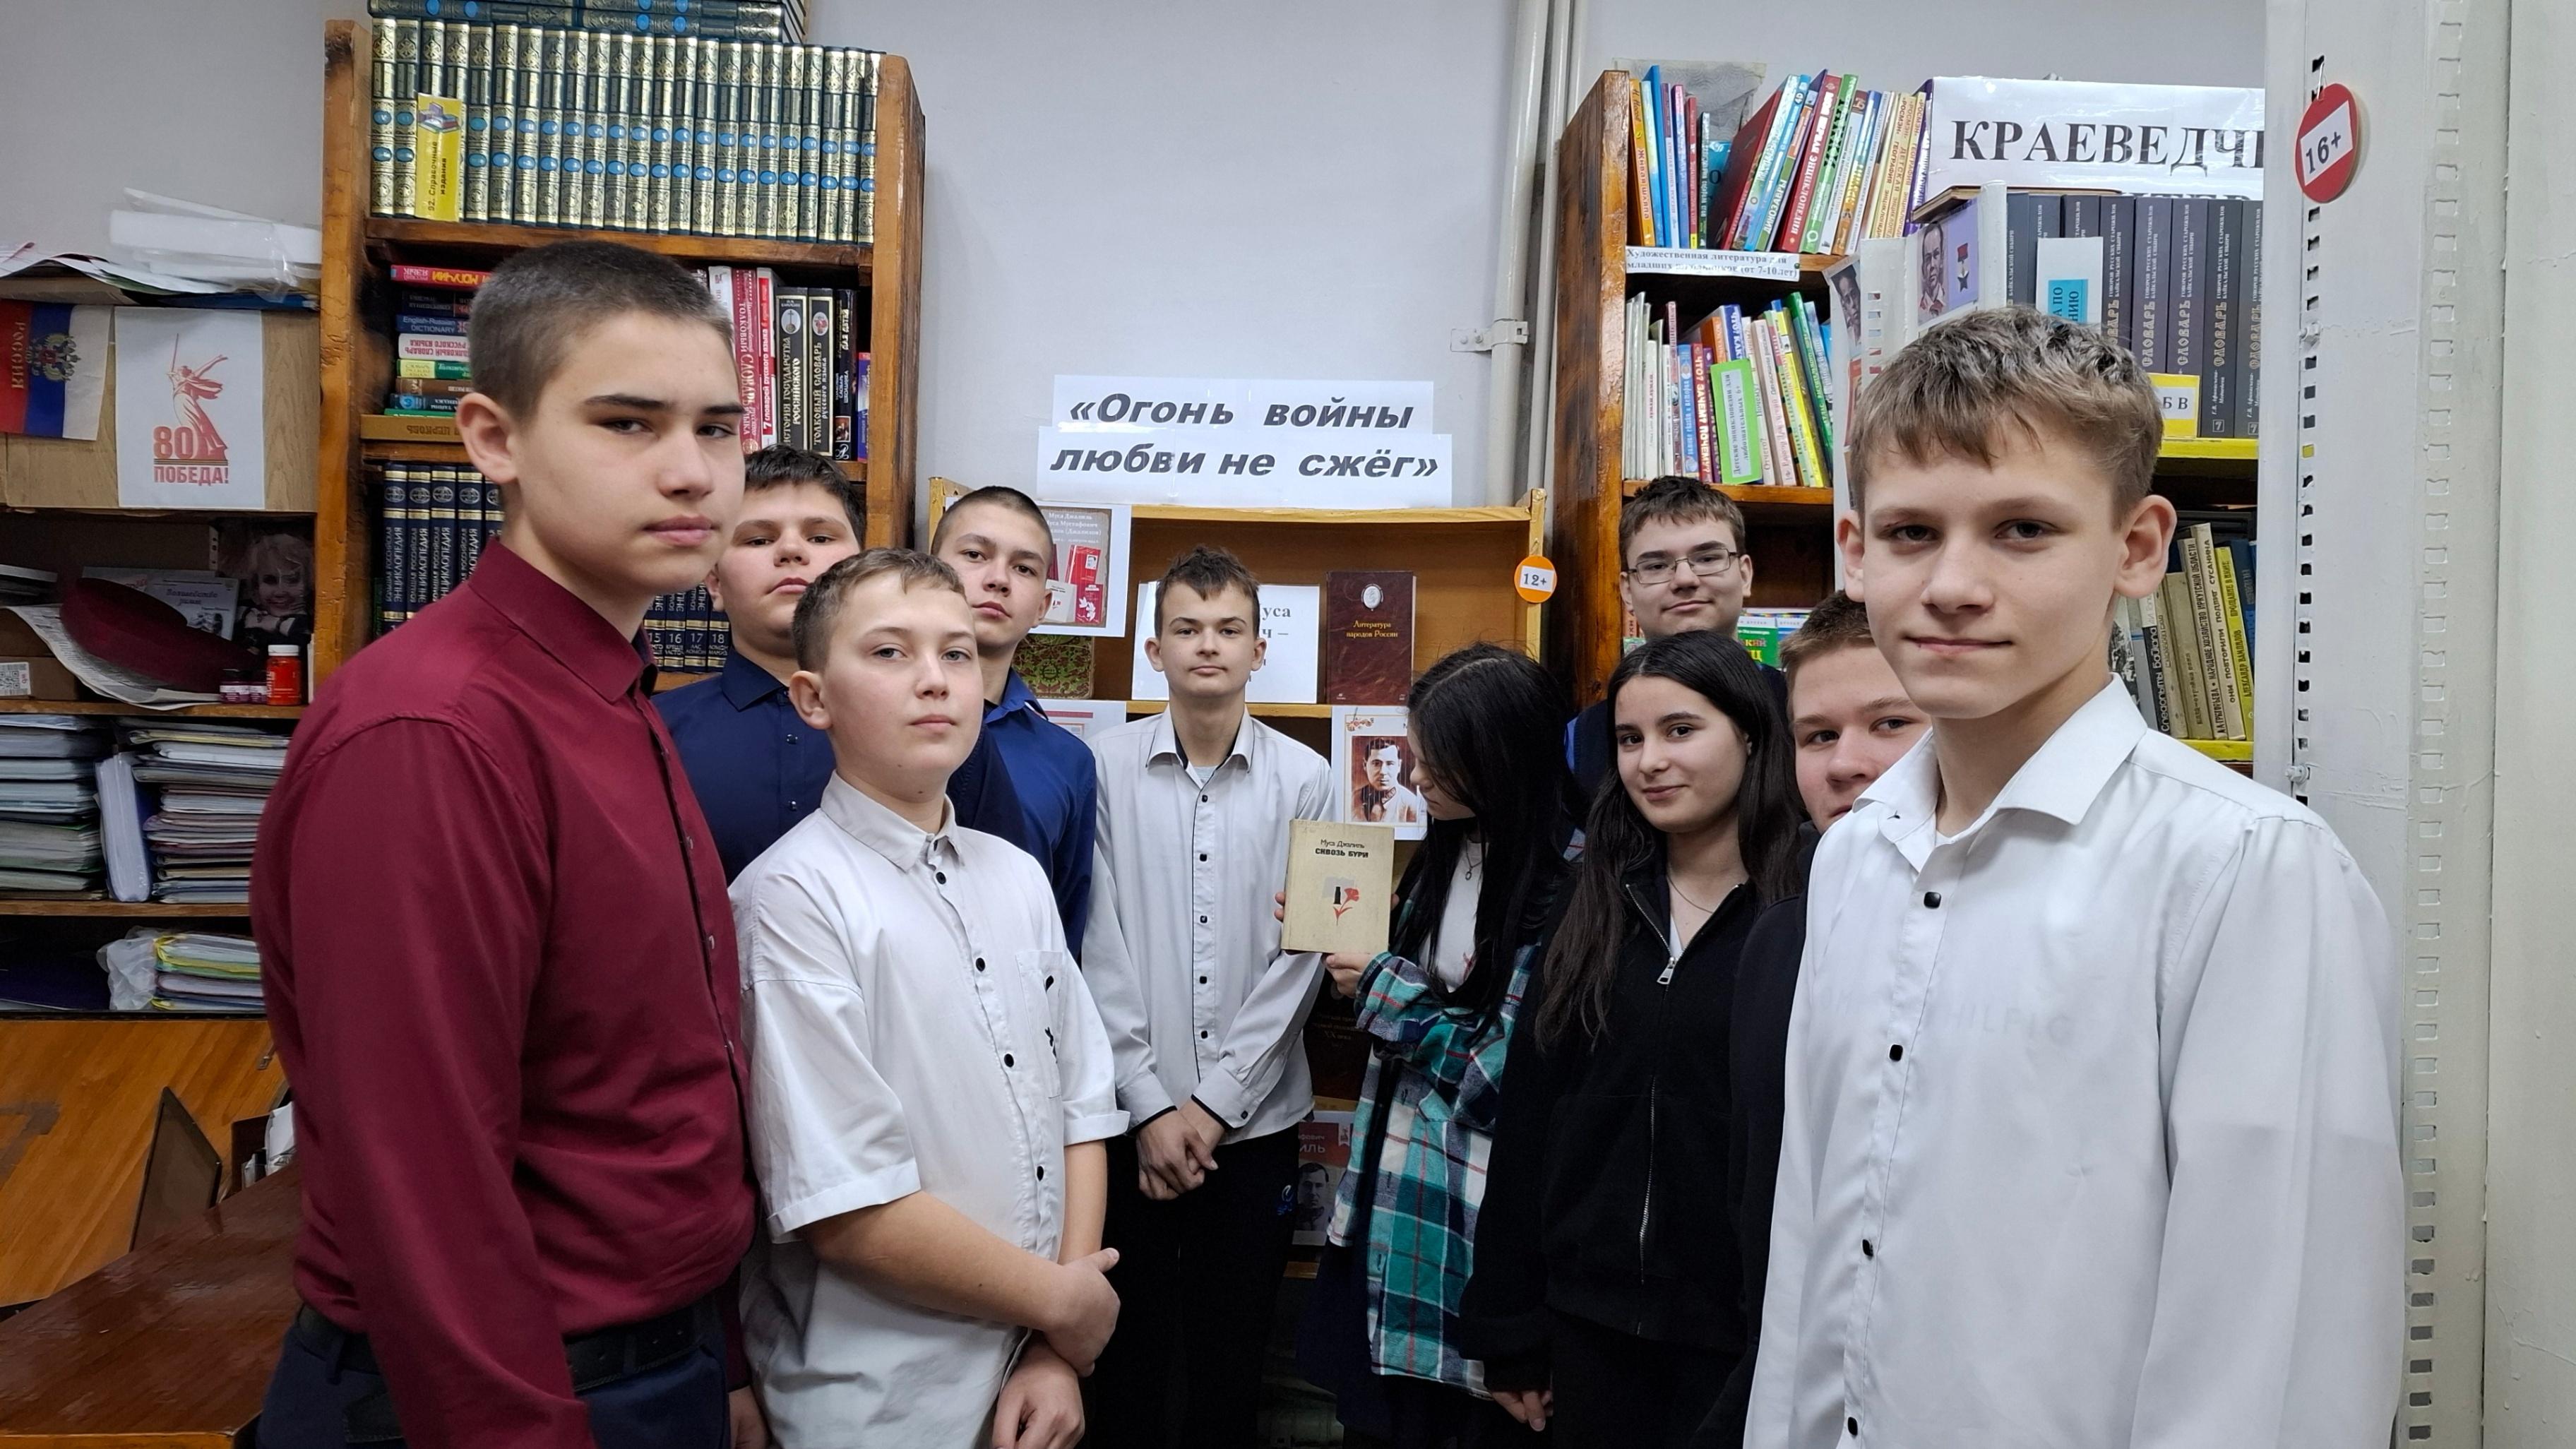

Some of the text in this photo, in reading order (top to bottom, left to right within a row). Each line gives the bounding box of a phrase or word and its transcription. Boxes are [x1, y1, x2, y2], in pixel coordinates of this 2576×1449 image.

[428, 141, 438, 196] Справочные
[1886, 141, 1900, 184] ГЕОГРАФИЯ
[1895, 146, 1907, 192] ДЕТСКАЯ
[2306, 131, 2341, 174] 16+
[1638, 148, 1650, 219] Живая шляпа
[1791, 155, 1819, 234] ЭНЦИКЛОПЕДИЯ
[1763, 179, 1787, 234] ДИНОЗАВРЫ
[403, 268, 429, 276] ЯЗЫК
[1626, 249, 1767, 264] Художественная литература
[432, 271, 478, 285] МОГУЧИЙ
[2053, 287, 2063, 304] ПО
[402, 316, 455, 326] English-Russian
[410, 325, 455, 333] DICTIONARY
[2107, 300, 2119, 345] ОВАРЬ
[2142, 302, 2155, 367] СЛОВАРЬ
[2177, 300, 2190, 366] СЛОВАРЬ
[2214, 302, 2227, 366] СЛОВАРЬ
[2249, 304, 2262, 369] СЛОВАРЬ
[11, 321, 26, 389] РОССИЯ
[405, 347, 434, 356] СЛОВАРЬ
[435, 340, 466, 349] РУССКОГО
[739, 302, 756, 405] ТОЛКОВЫЙ СЛОВАРЬ
[782, 337, 792, 400] ГОСУДАРСТВА
[792, 357, 801, 424] РОССИЙСКОГО
[813, 342, 822, 445] ТОЛКОВЫЙ СЛОВАРЬ
[2163, 397, 2188, 410] Б В
[763, 421, 771, 429] 7
[1070, 393, 1414, 429] «Огонь войны
[1695, 355, 1710, 473] ЧТО? ЗАЧЕМ? ПОЧЕМУ?
[1727, 389, 1737, 443] энциклопедии
[153, 426, 194, 459] 80
[406, 425, 450, 436] ЦЕРКОВЬ
[1737, 398, 1749, 460] любознательных
[1049, 443, 1438, 478] любви не сжёг»
[1732, 444, 1741, 475] Детские
[1760, 438, 1771, 470] Отчего?
[153, 465, 229, 487] ПОБЕДА!
[1049, 512, 1092, 521] Муса Джалиль
[393, 527, 403, 603] ЭНЦИКЛОПЕДИЯ
[418, 528, 428, 603] ЭНЦИКЛОПЕДИЯ
[1524, 573, 1547, 586] 12+
[1262, 607, 1292, 621] уса
[2187, 543, 2216, 679] НАРОДНОЕ ХОЗЯЙСТВО ИРКУТСКОЙ ОБЛАСТИ
[2225, 584, 2238, 616] ПРОЩАНИЕ
[669, 633, 682, 643] 16
[690, 633, 703, 643] 17
[712, 633, 724, 643] 18
[1353, 620, 1392, 629] Литература
[2205, 539, 2236, 703] ОНИ ПОВТОРИЛИ ПОДВИГ СУСАНИНА
[2149, 626, 2161, 669] Байкала
[2233, 630, 2246, 662] ВАМПИЛОВ
[2238, 664, 2253, 698] АЛЕКСАНДР
[2155, 672, 2170, 732] Следопыты
[1320, 838, 1365, 849] Муса Джалиль
